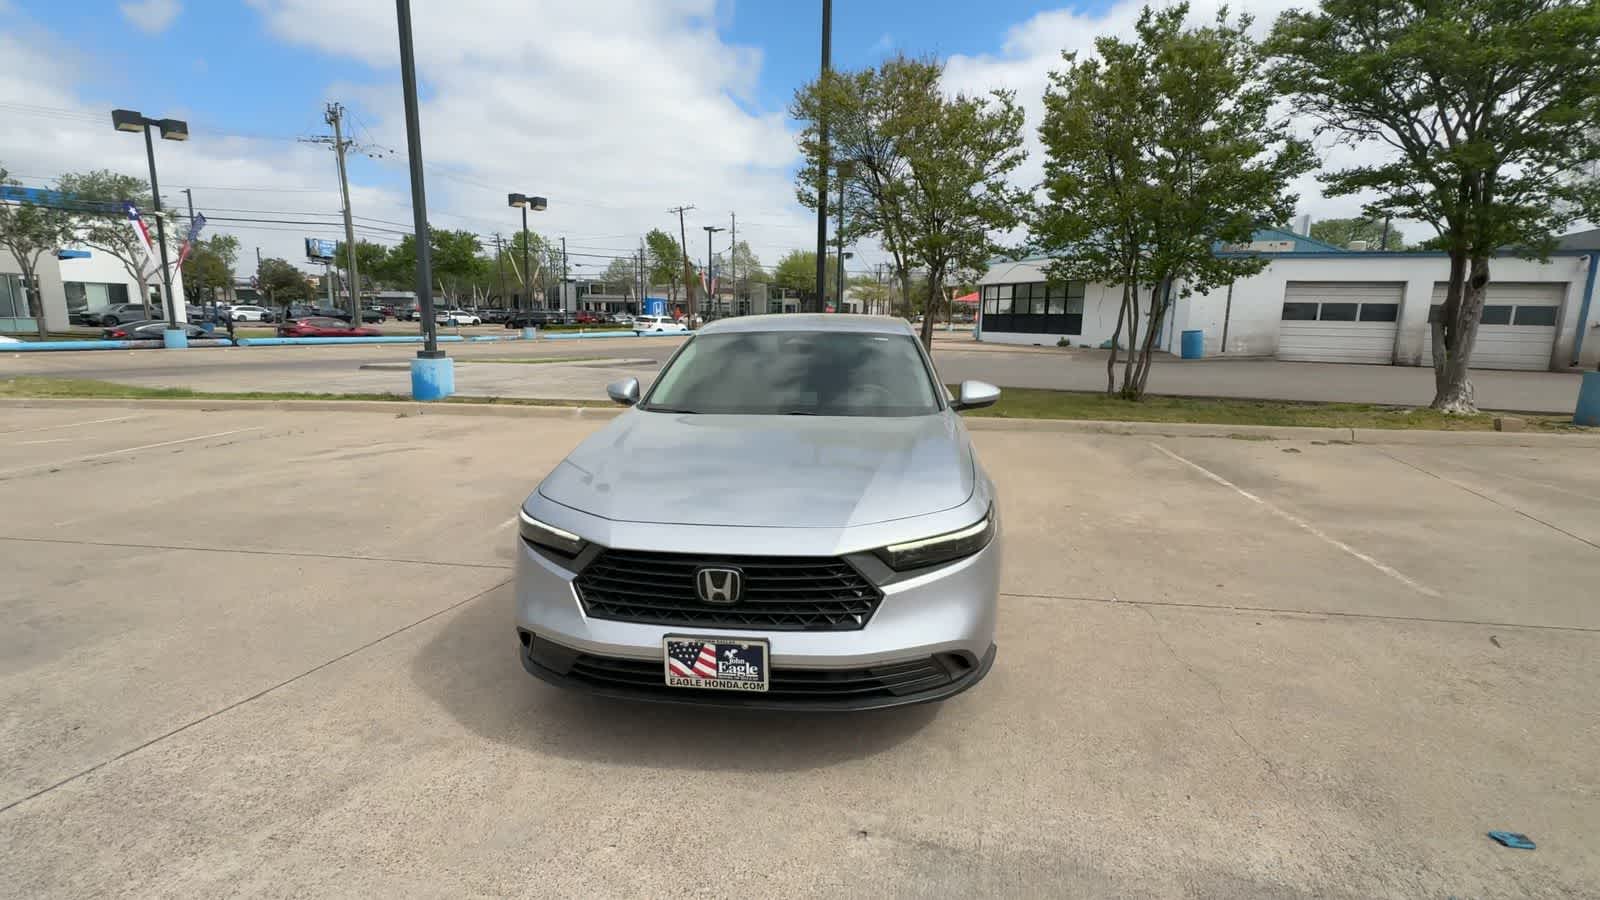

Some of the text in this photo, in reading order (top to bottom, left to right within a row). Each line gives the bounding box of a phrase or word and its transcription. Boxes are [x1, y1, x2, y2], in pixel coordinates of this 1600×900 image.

[729, 657, 745, 665] John
[718, 661, 759, 677] Eagle
[670, 678, 765, 690] EAGLE HONDA.COM
